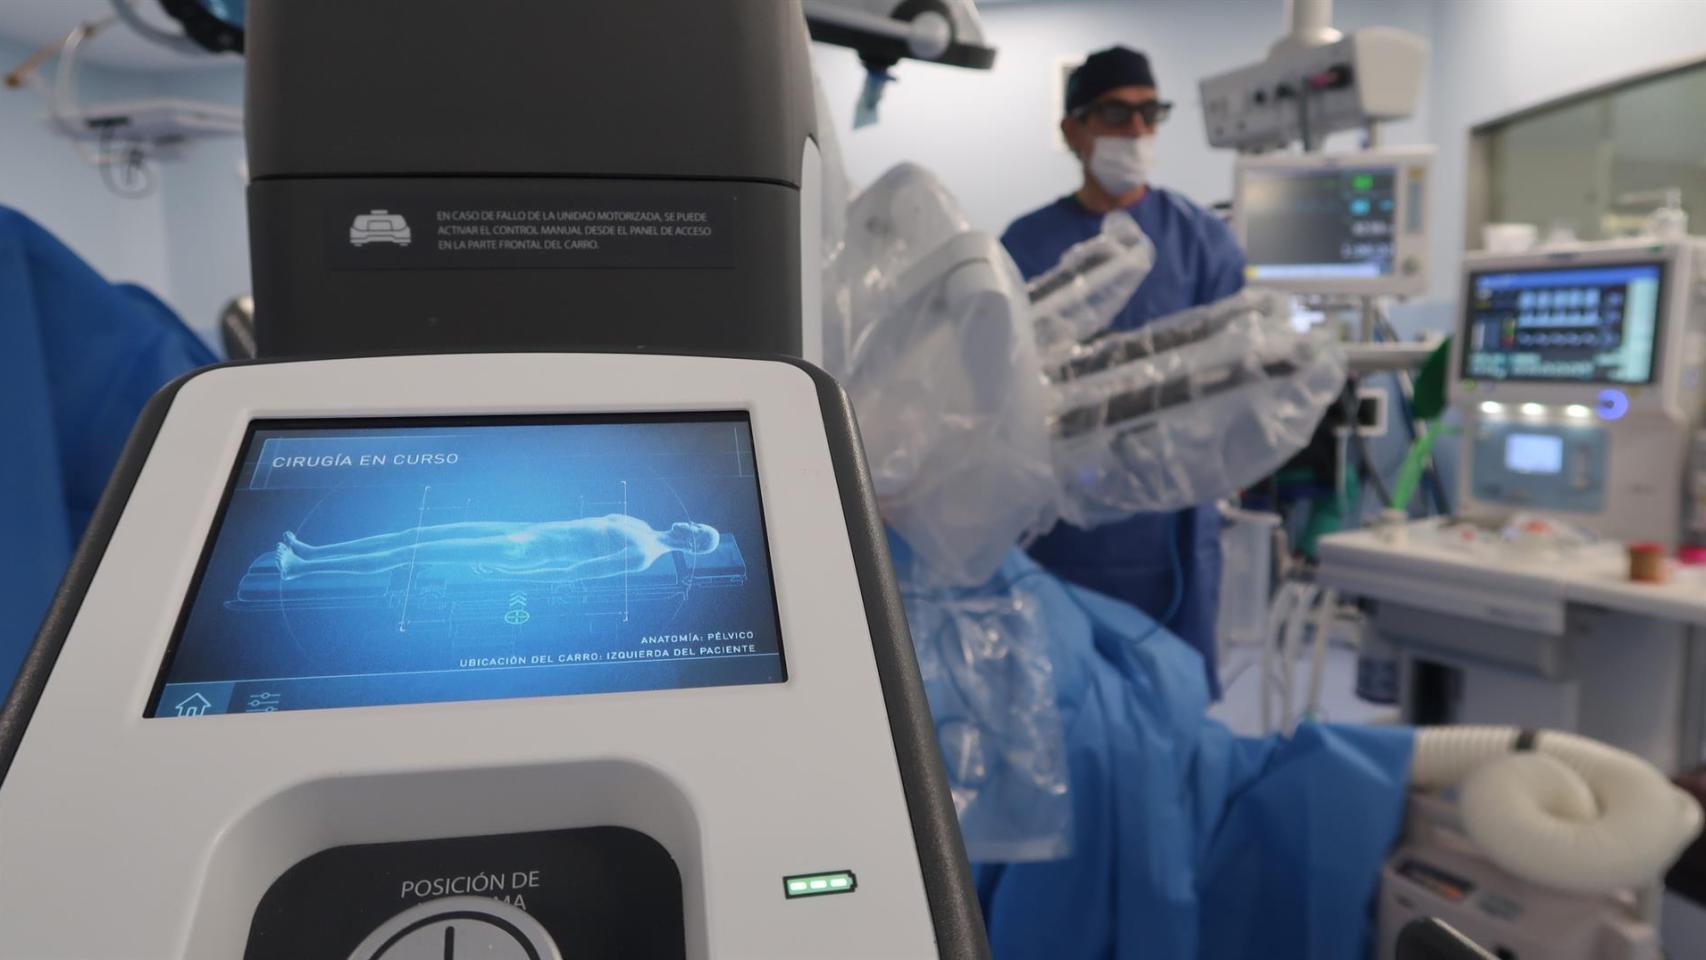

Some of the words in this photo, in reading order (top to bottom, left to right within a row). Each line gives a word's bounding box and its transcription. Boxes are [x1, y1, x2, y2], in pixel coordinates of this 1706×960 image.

[436, 210, 450, 221] EN
[451, 210, 480, 221] CASO
[481, 210, 495, 221] DE
[496, 210, 526, 221] FALLO
[527, 210, 541, 221] DE
[542, 210, 556, 221] LA
[556, 210, 596, 221] UNIDAD
[597, 211, 662, 222] MOTORIZADA,
[663, 212, 676, 222] SE
[677, 212, 707, 222] PUEDE
[437, 225, 479, 235] ACTIVAR
[480, 225, 491, 235] EL
[492, 225, 539, 235] CONTROL
[540, 225, 583, 235] MANUAL
[584, 225, 616, 235] DESDE
[617, 226, 628, 235] EL
[629, 226, 660, 236] PANEL
[660, 226, 673, 236] DE
[674, 226, 712, 236] ACCESO
[438, 239, 452, 250] EN
[452, 239, 467, 250] LA
[467, 239, 497, 249] PARTE
[499, 239, 542, 250] FRONTAL
[543, 239, 562, 250] DEL
[563, 239, 600, 250] CARRO.
[271, 453, 353, 468] CIRUGÍA
[359, 455, 386, 466] EN
[393, 453, 459, 465] CURSO
[640, 632, 704, 645] ANATOMÍA:
[707, 631, 754, 641] PÉLVICO
[459, 656, 527, 668] UBICACIÓN
[531, 655, 554, 664] DEL
[558, 652, 603, 663] CARRO:
[606, 649, 670, 660] IZQUIERDA
[673, 647, 696, 657] DEL
[700, 644, 756, 655] PACIENTE
[400, 871, 505, 899] POSICIÓN
[511, 870, 540, 889] DE
